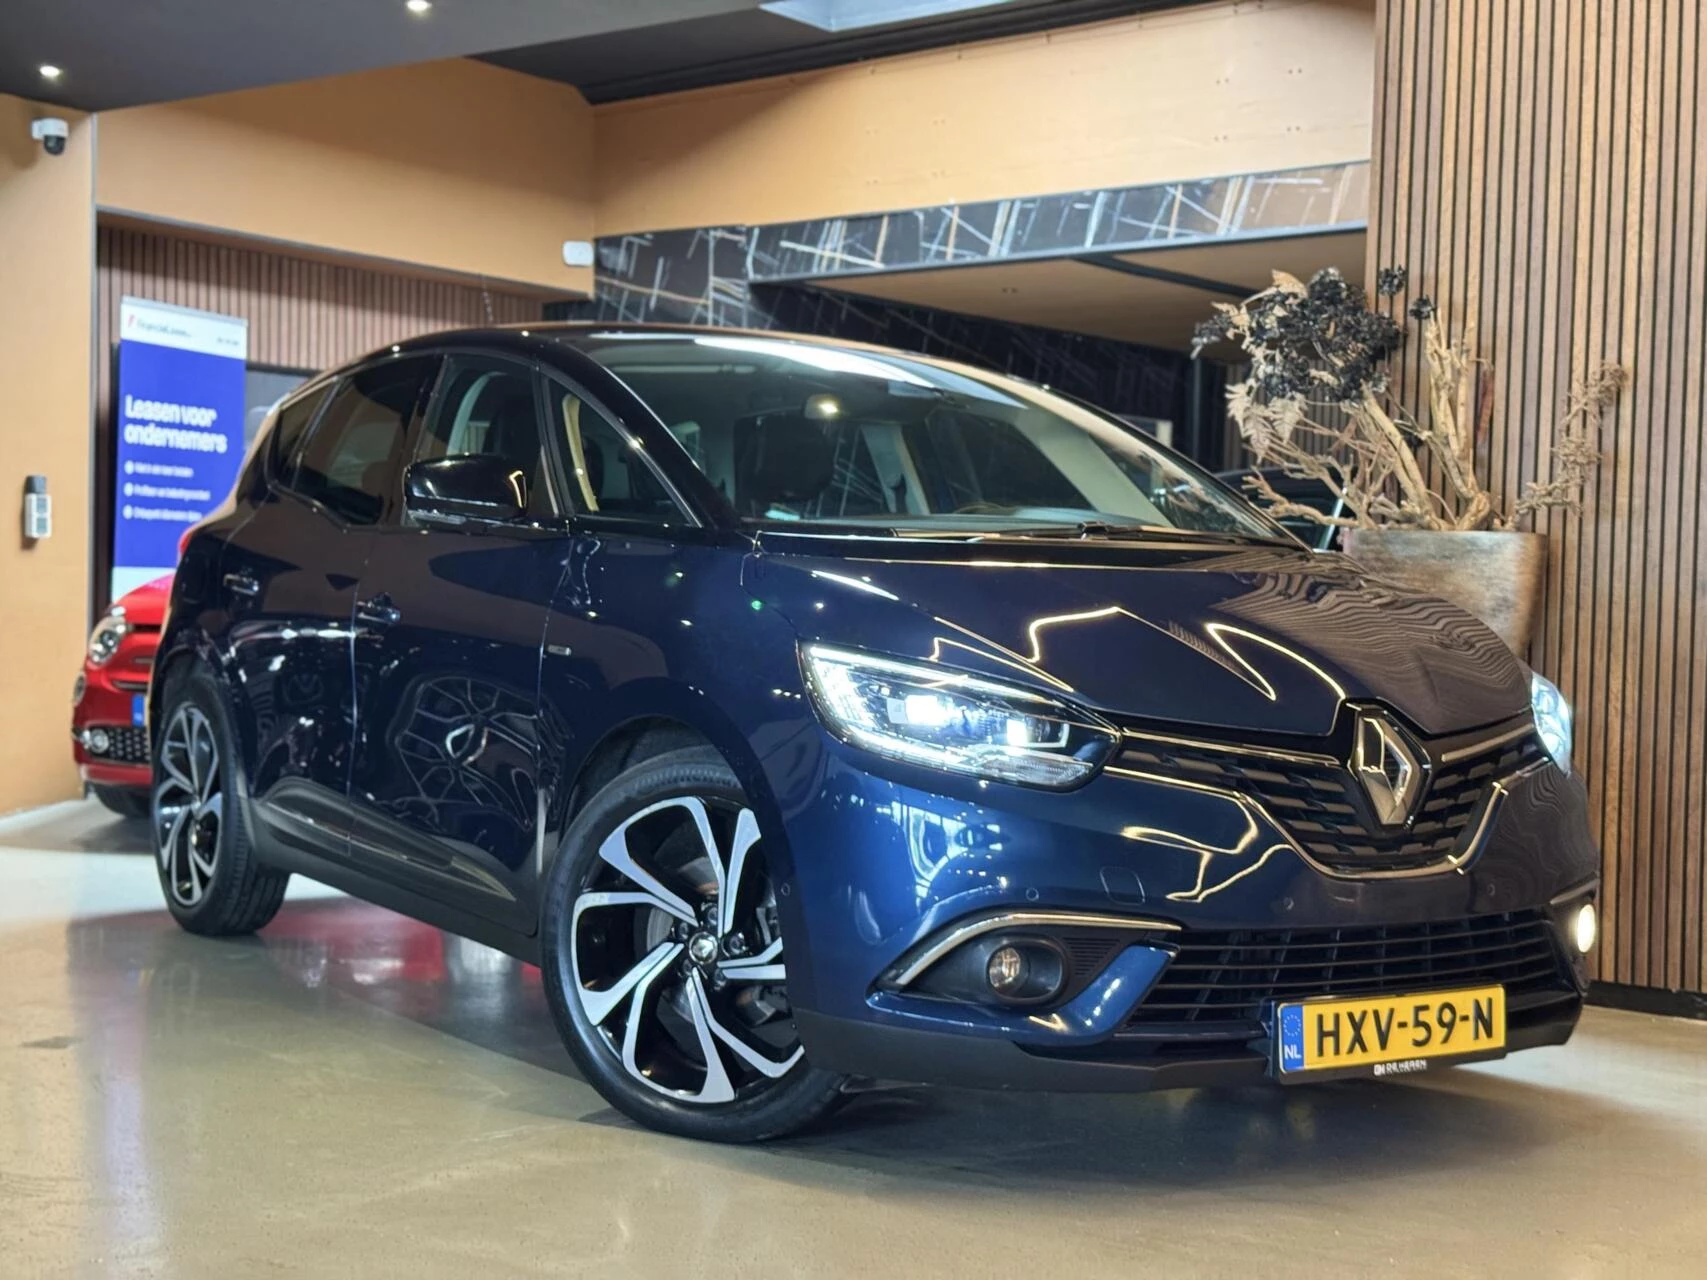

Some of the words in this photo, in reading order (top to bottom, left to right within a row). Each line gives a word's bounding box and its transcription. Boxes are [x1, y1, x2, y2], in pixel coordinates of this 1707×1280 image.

[124, 394, 181, 424] Leasen
[181, 404, 217, 428] voor
[123, 422, 228, 454] ondernemers
[1316, 997, 1494, 1058] HXV-59-N
[1284, 1044, 1302, 1060] NL
